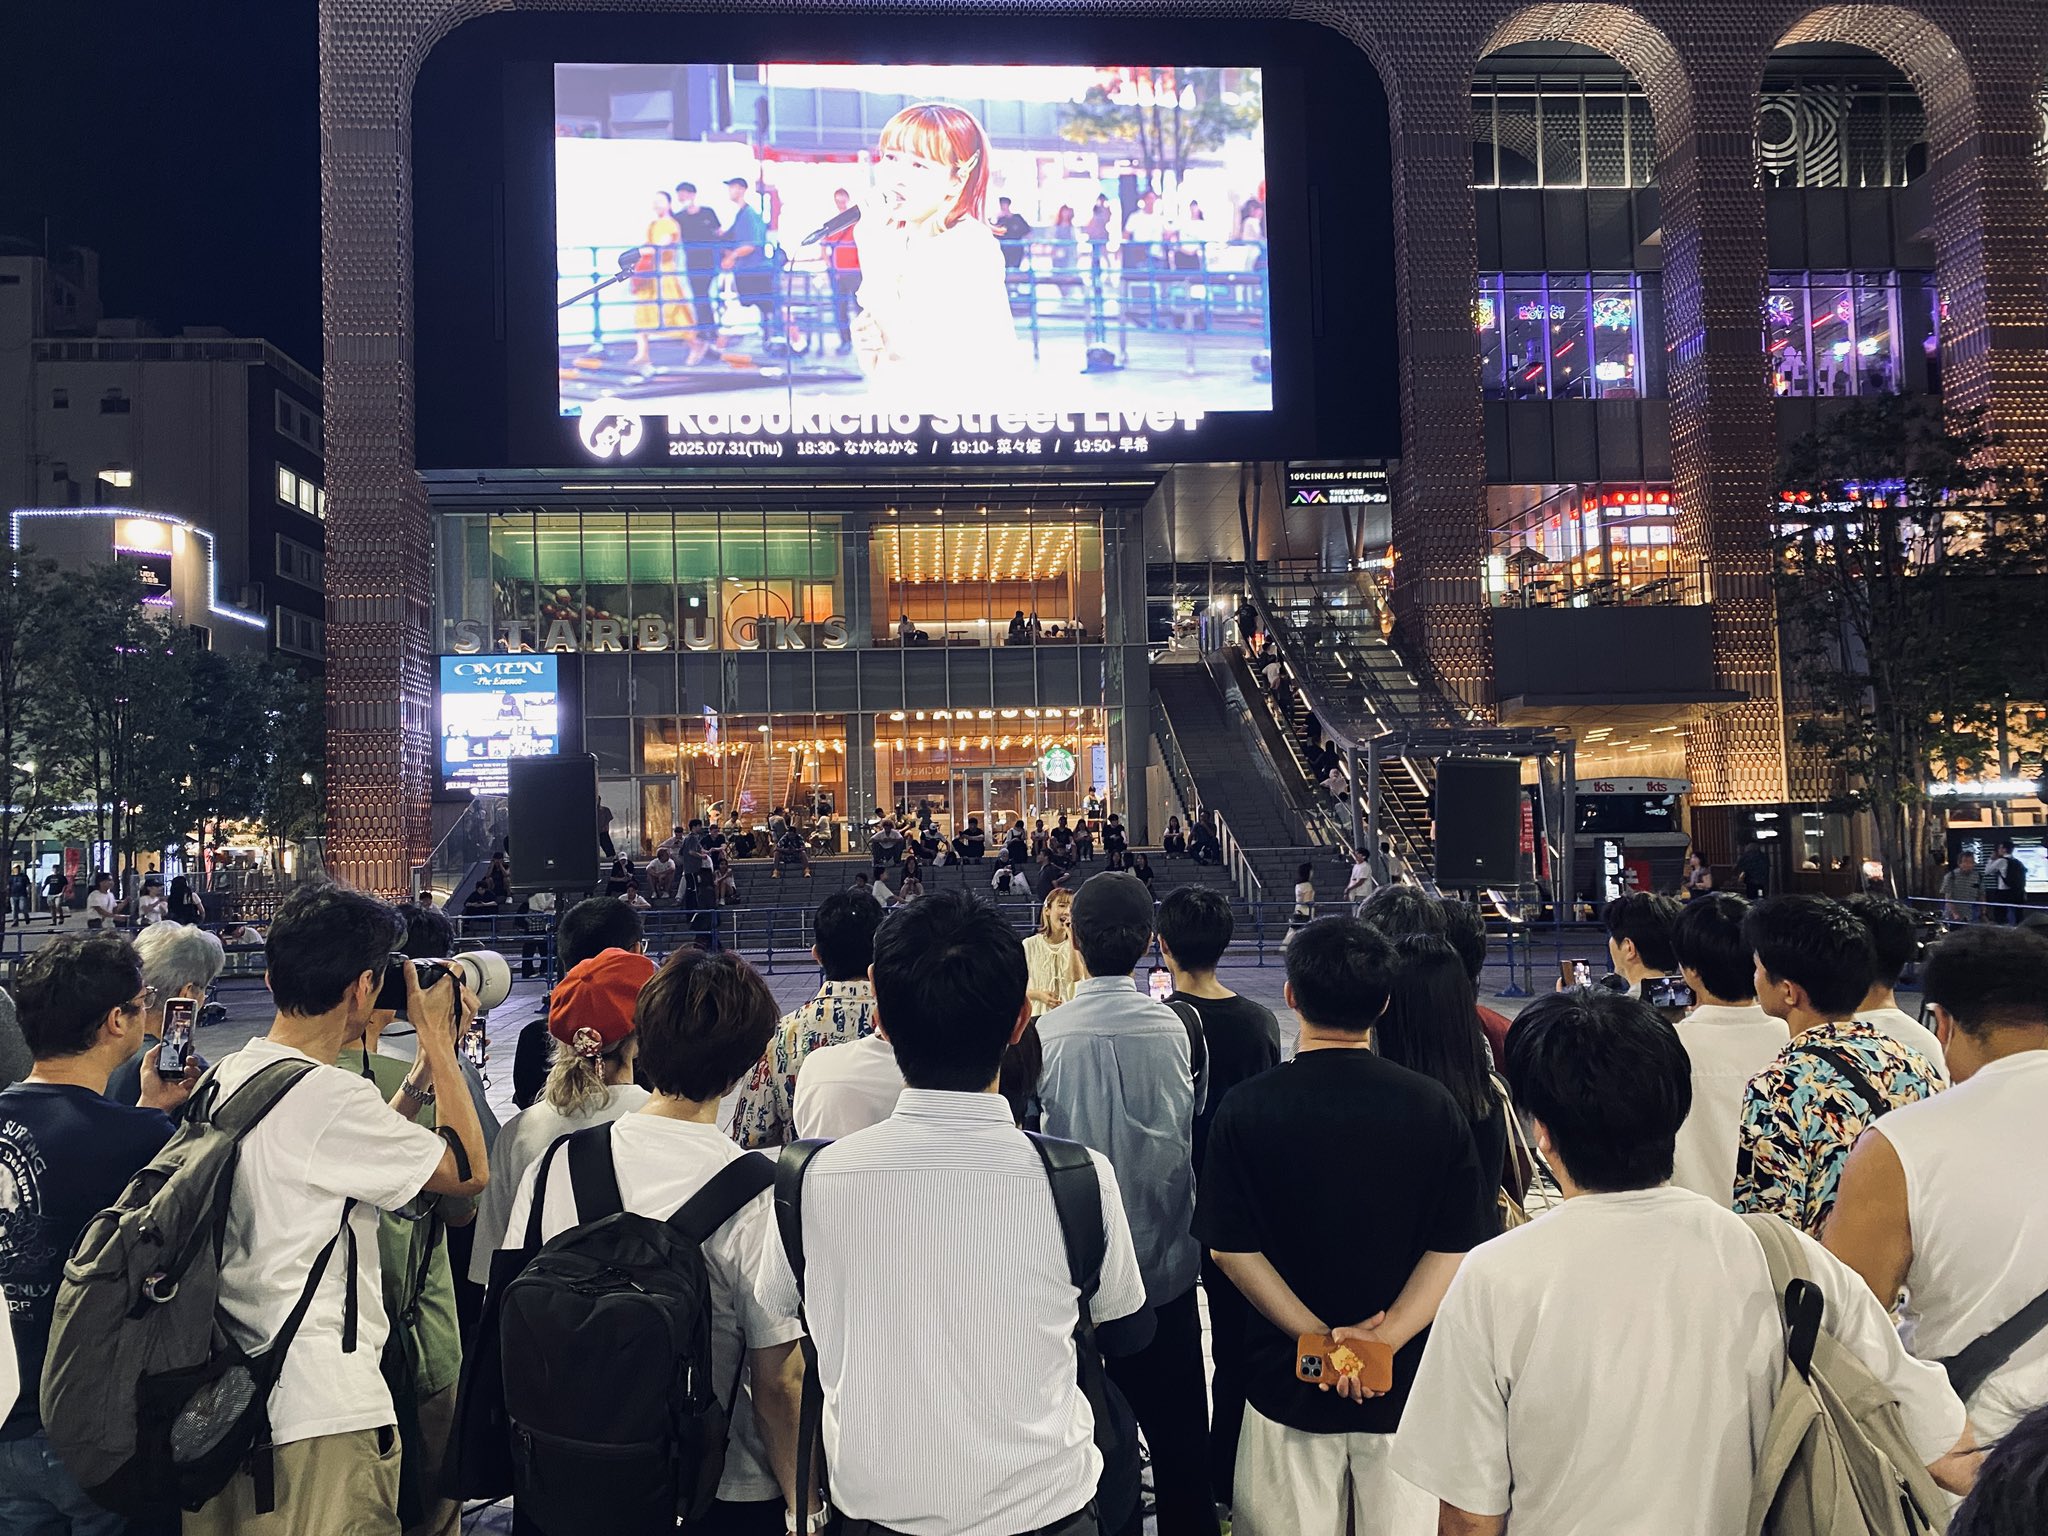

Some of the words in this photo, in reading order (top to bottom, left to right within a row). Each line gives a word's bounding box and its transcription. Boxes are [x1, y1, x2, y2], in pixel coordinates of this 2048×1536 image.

[669, 440, 783, 457] 2025.07.31(Thu)
[844, 439, 918, 455] なかねかな
[996, 438, 1042, 454] 菜々姫
[1119, 436, 1149, 453] 早希
[1290, 472, 1344, 481] 109CINEMAS
[1346, 471, 1386, 480] PREMIUM
[453, 615, 850, 654] STARBUCKS
[453, 661, 544, 676] OMEN
[1594, 782, 1615, 792] tkts
[1646, 781, 1667, 792] tkts
